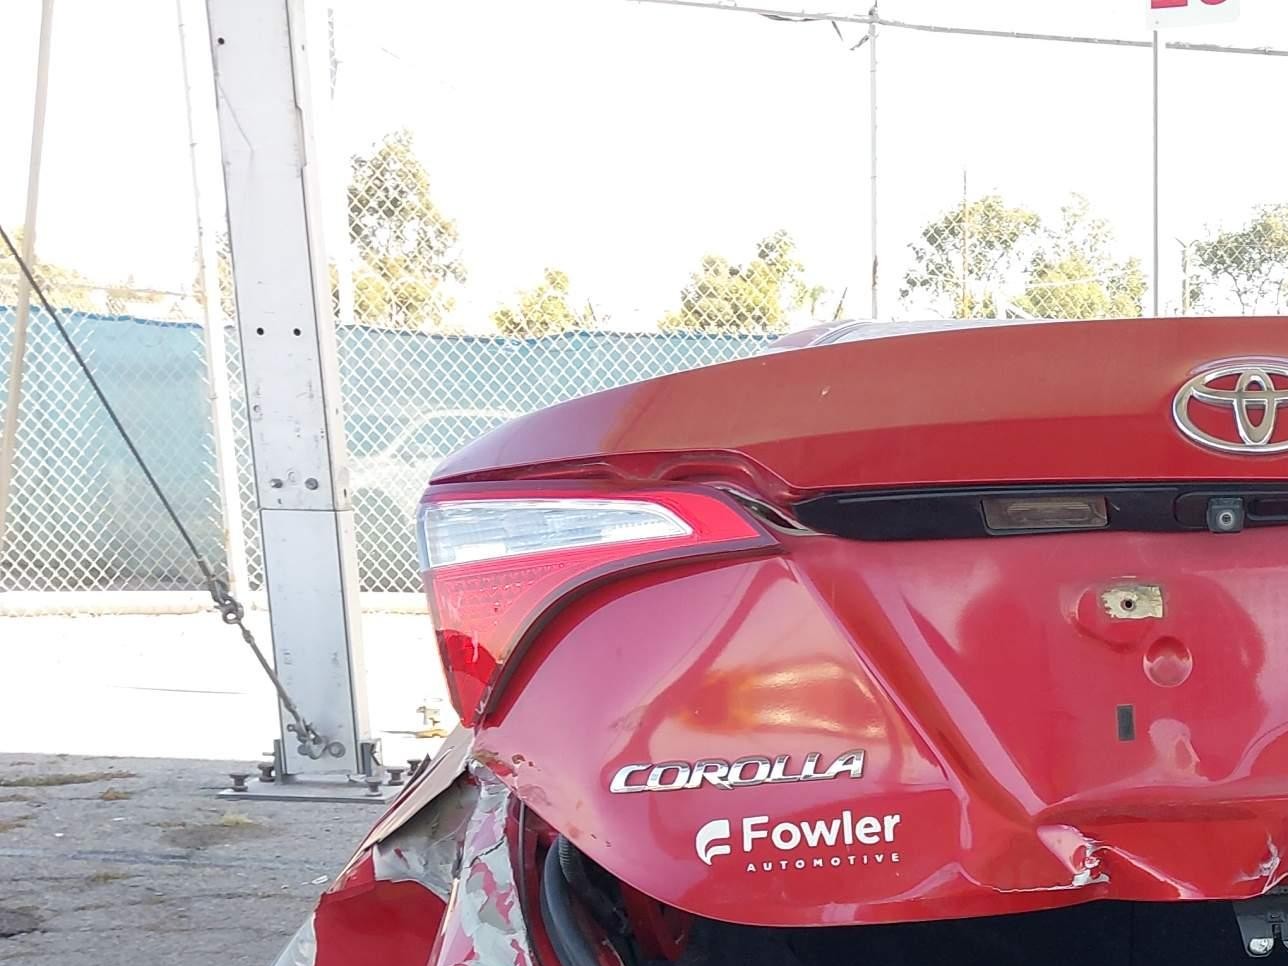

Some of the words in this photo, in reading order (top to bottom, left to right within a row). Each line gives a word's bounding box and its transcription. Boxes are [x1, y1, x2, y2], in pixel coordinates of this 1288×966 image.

[609, 749, 867, 794] COROLLA
[743, 810, 901, 852] Fowler
[746, 852, 901, 872] AUTOMOTIVE
